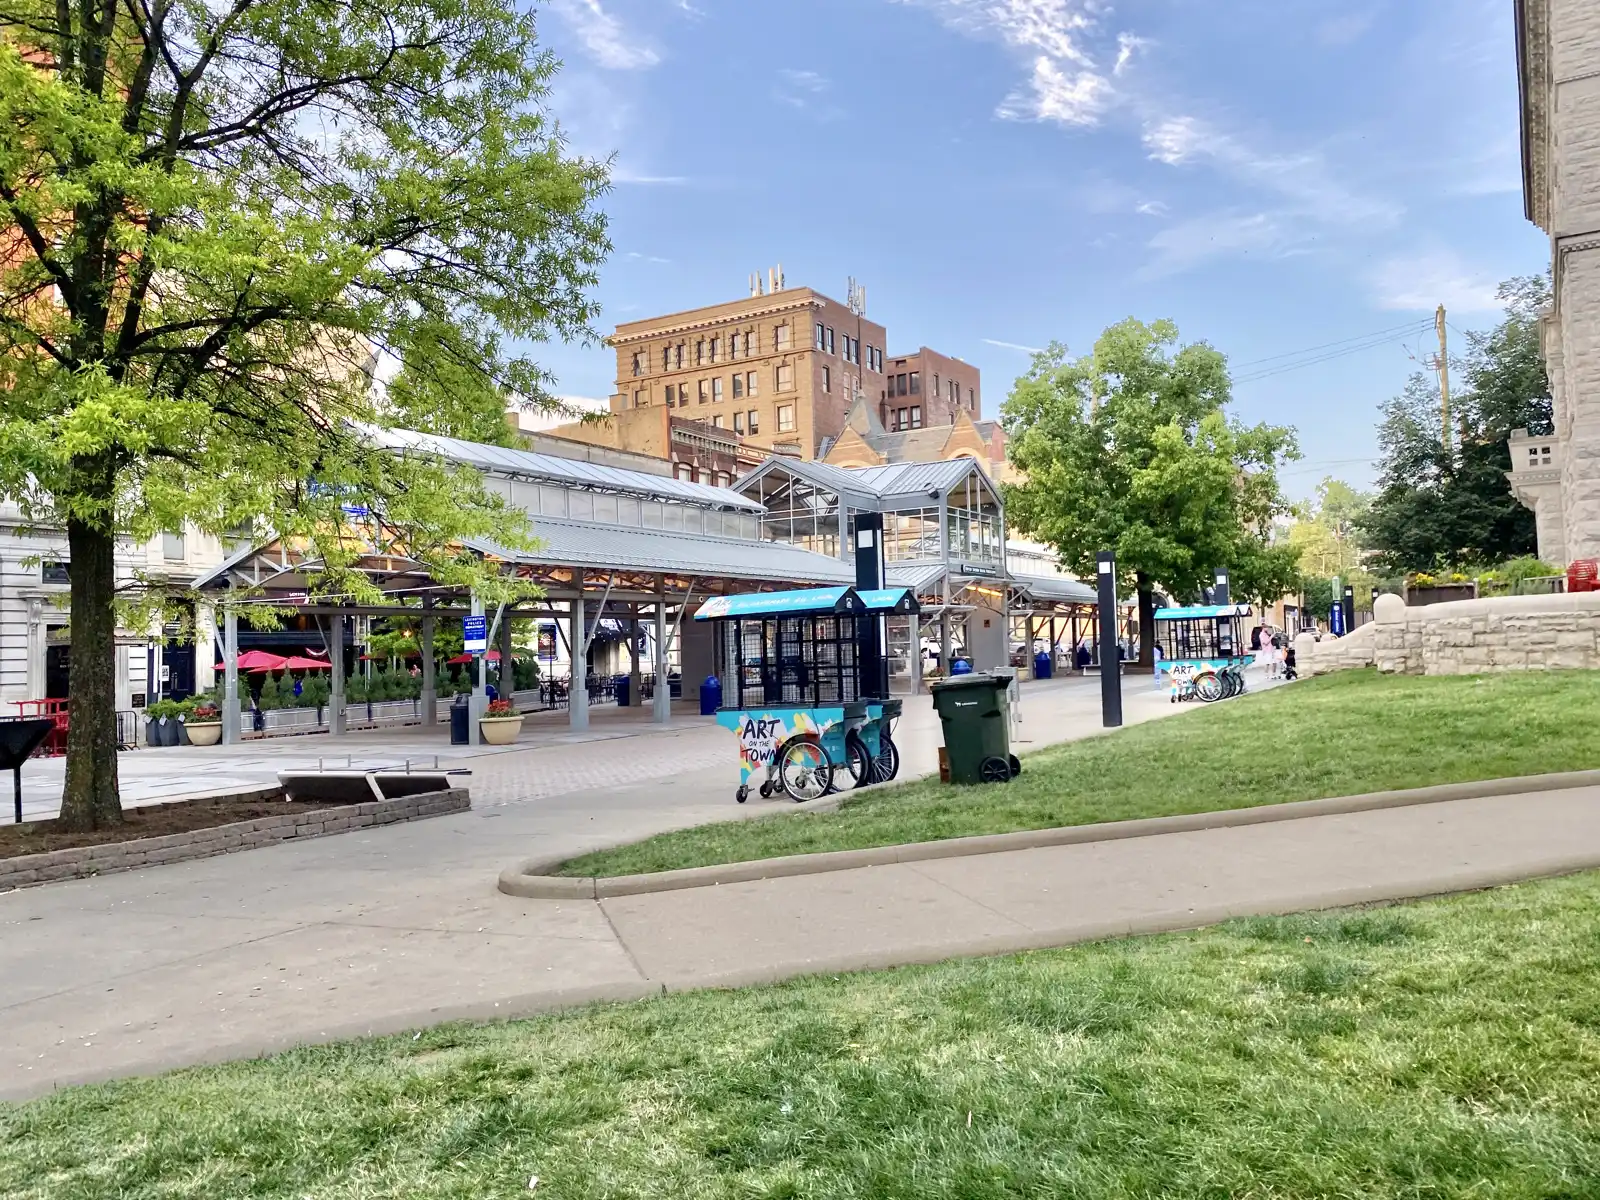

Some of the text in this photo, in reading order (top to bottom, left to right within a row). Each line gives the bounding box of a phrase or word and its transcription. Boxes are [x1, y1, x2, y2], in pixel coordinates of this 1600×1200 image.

[1173, 666, 1194, 675] ART
[742, 719, 780, 739] ART
[741, 747, 778, 762] TOWN
